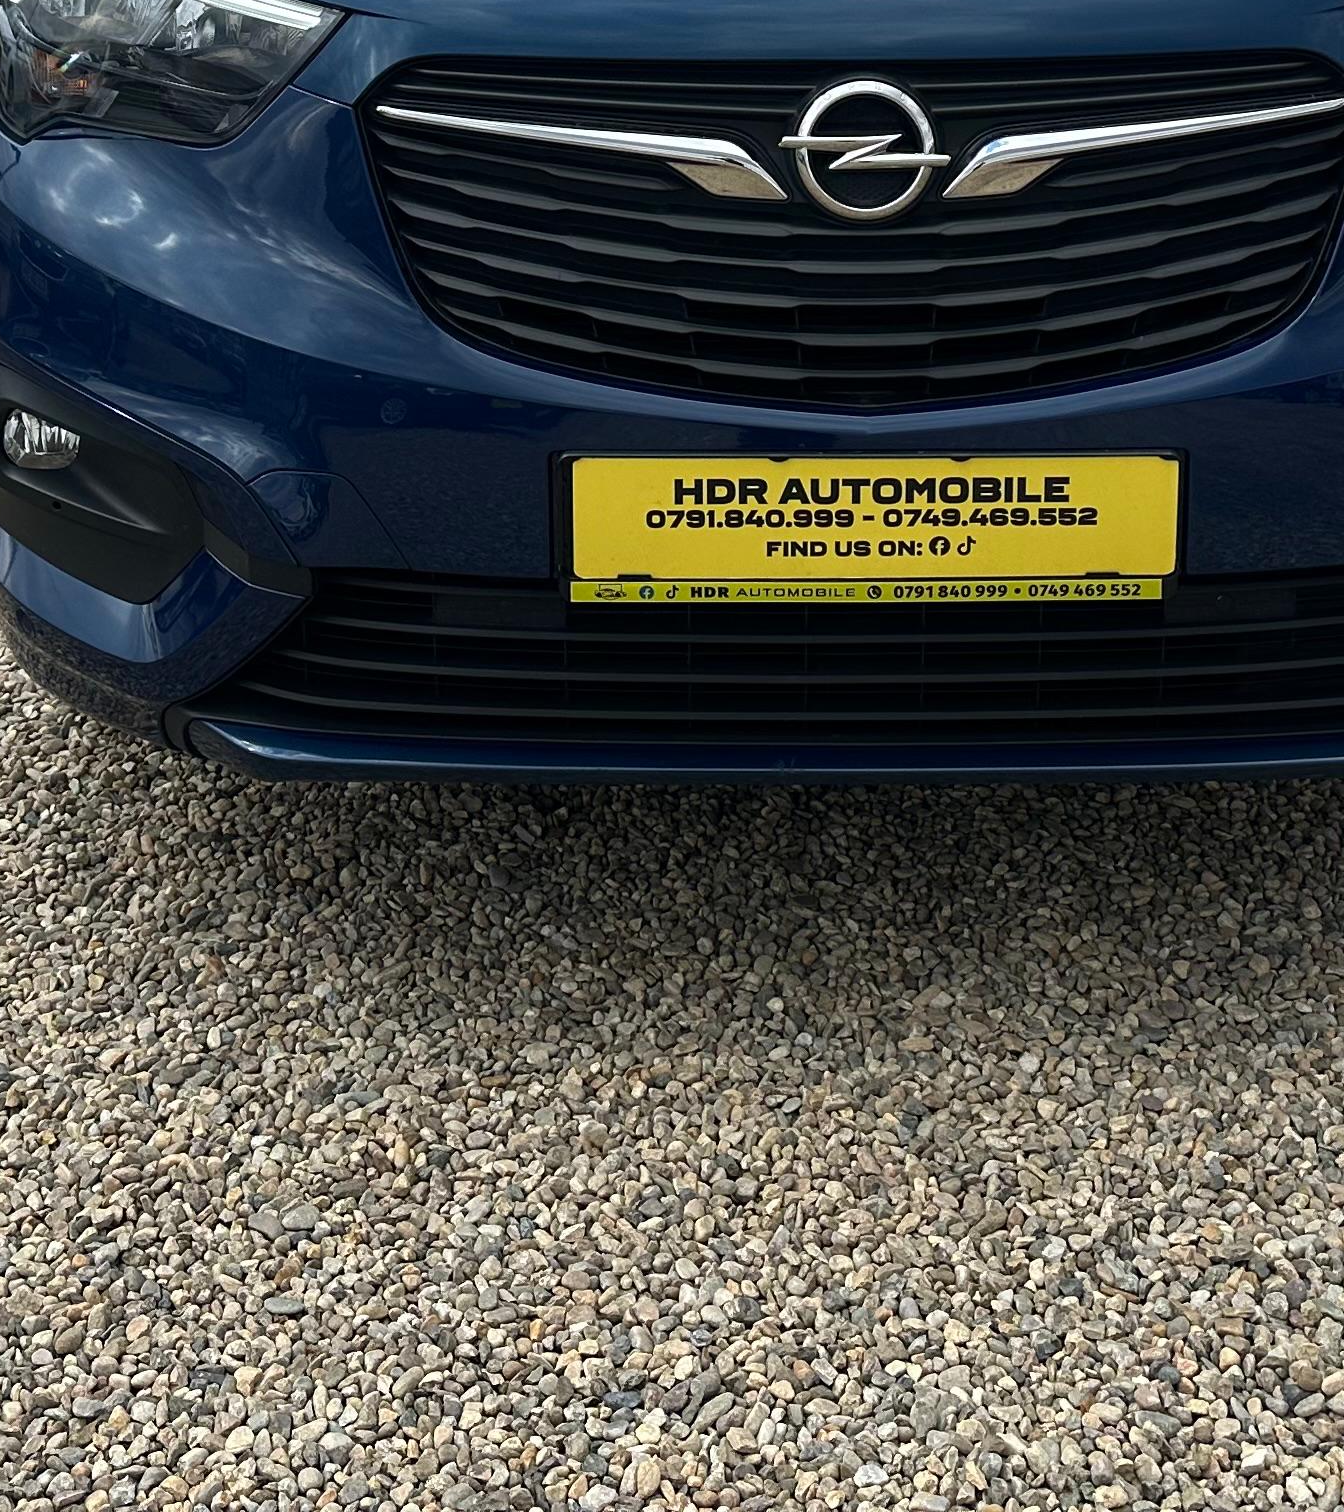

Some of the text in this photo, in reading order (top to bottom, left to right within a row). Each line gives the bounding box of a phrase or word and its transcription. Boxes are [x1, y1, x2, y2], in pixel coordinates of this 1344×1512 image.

[674, 477, 1070, 505] HDR AUTOMOBILE
[645, 509, 854, 529] 0791.840.999
[882, 507, 1098, 527] 0749.469.552
[766, 540, 923, 557] FIND US ON:
[690, 584, 1141, 598] HDR AUTOMOBILE 0791 840 999 0749 469 552
